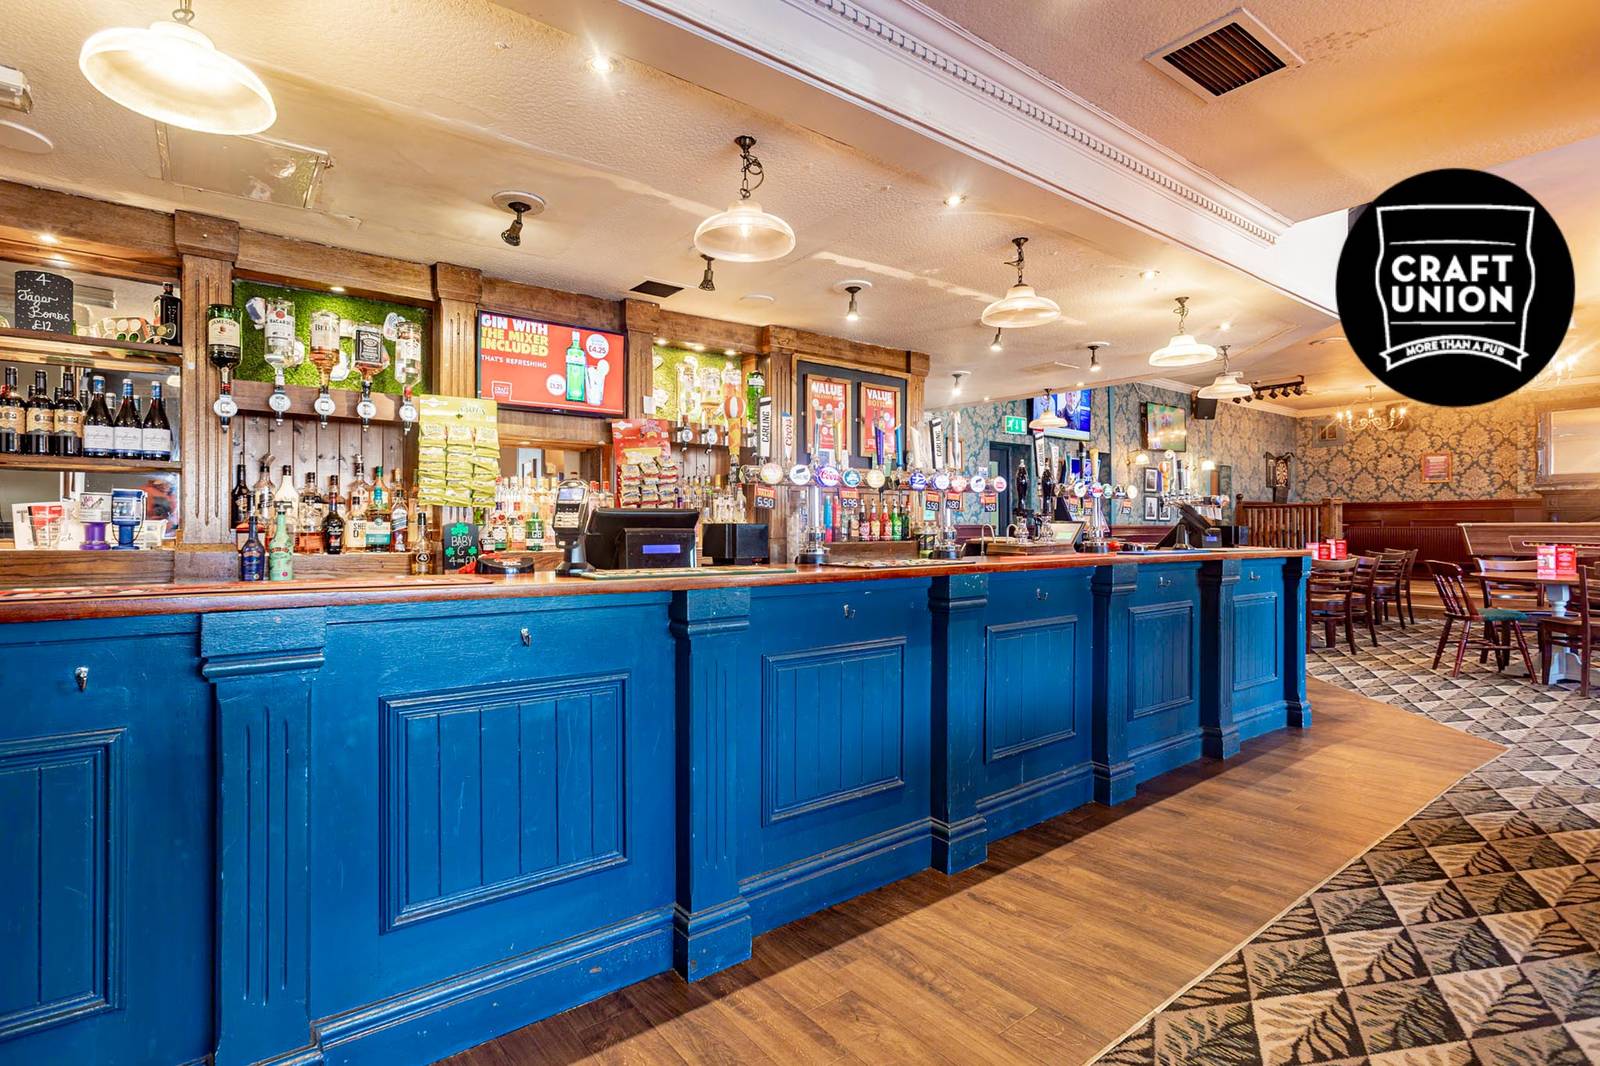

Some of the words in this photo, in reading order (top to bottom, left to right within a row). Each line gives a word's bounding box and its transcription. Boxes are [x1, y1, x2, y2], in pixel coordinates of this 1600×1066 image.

[35, 273, 52, 286] 4
[28, 305, 70, 322] Bombs
[31, 320, 54, 331] £12
[210, 319, 236, 328] JAMESON
[269, 318, 292, 326] BACARDI
[481, 314, 508, 330] GIN
[512, 318, 548, 335] WITH
[481, 326, 505, 341] THE
[508, 330, 549, 346] MIXER
[481, 337, 549, 357] INCLUDED
[481, 354, 504, 363] THAT'S
[505, 358, 547, 369] REFRESHING
[811, 381, 843, 397] VALUE
[866, 388, 893, 401] VALUE
[451, 535, 473, 547] BABY
[457, 546, 465, 556] G
